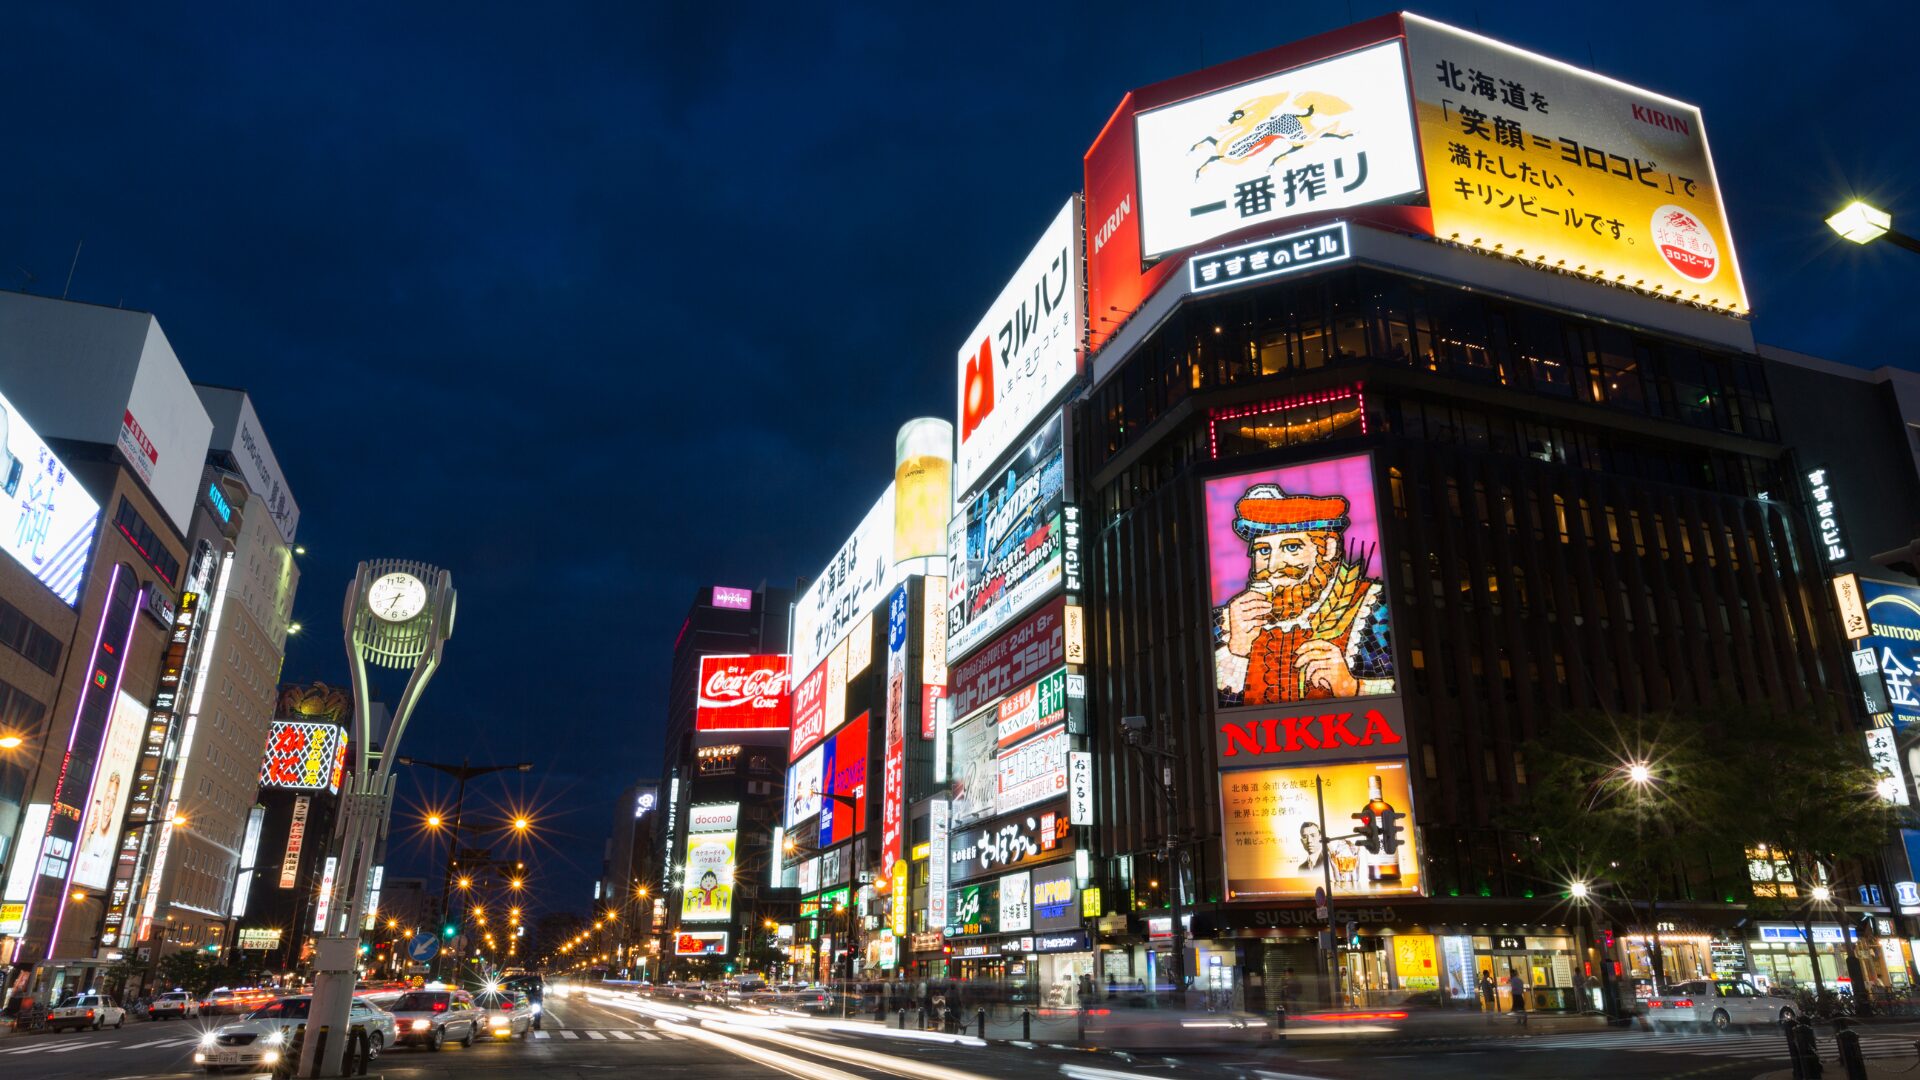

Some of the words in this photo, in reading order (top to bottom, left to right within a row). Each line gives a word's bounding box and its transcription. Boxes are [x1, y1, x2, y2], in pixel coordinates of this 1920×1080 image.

[1436, 59, 1549, 114] 北海道を
[1631, 103, 1690, 136] KIRIN
[1190, 151, 1369, 219] 一番搾り
[1448, 141, 1575, 197] 満たしたい、
[1094, 193, 1131, 254] KIRIN
[1454, 178, 1635, 246] キリンビールです。
[1200, 236, 1338, 283] すすきのビル
[1657, 228, 1713, 256] 北海道の
[1665, 248, 1713, 270] ヨロコビール
[998, 246, 1068, 370] マルハン
[1808, 469, 1846, 561] すすきのビル
[1064, 506, 1081, 590] すすきのビル
[816, 535, 859, 613] 北海道は
[815, 553, 886, 657] サッポロビール
[1010, 629, 1034, 653] 24H
[1037, 613, 1055, 633] 8F
[752, 696, 779, 708] Coke
[796, 671, 823, 714] カラオケ
[1039, 674, 1064, 716] 青汁
[269, 725, 305, 783] かに
[1220, 709, 1403, 756] NIKKA
[1231, 783, 1260, 792] 北海道
[695, 815, 732, 825] docomo
[1056, 816, 1070, 840] 2F
[1034, 878, 1072, 905] SAPPORO
[1256, 911, 1350, 925] SUSUKO
